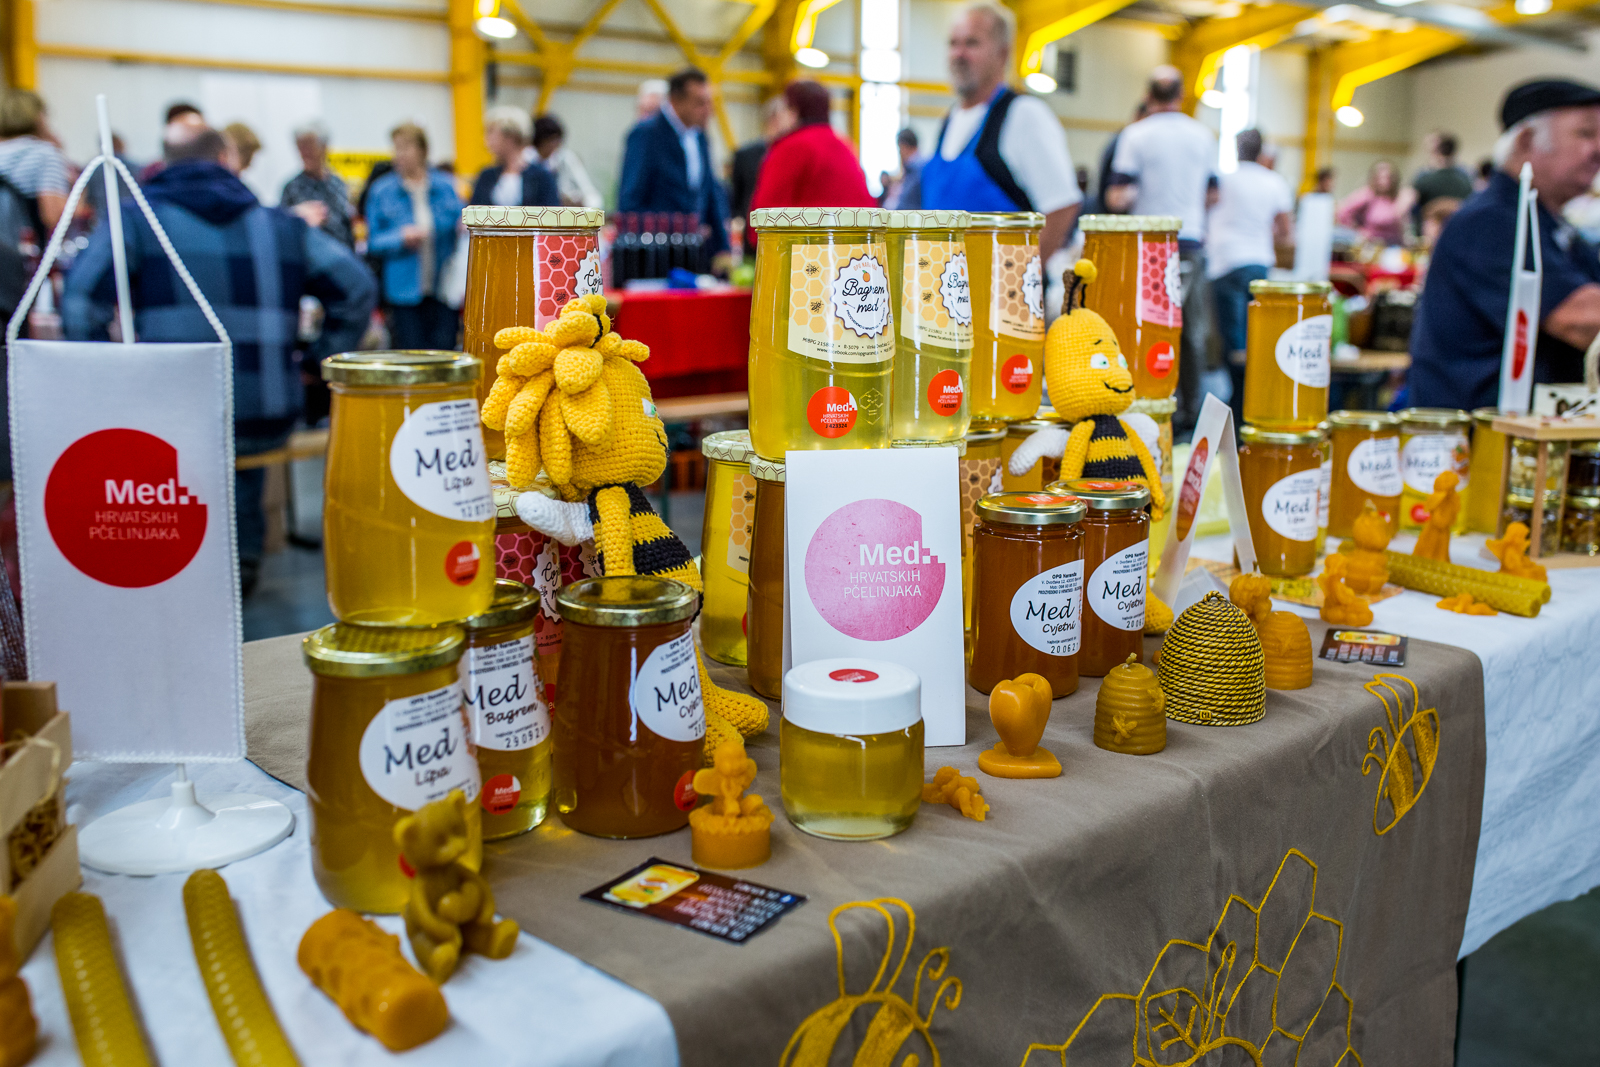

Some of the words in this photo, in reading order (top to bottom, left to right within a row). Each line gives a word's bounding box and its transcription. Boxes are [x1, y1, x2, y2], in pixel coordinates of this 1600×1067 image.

[842, 277, 885, 302] Bagrem
[856, 297, 879, 313] med
[414, 438, 480, 477] Med
[94, 510, 179, 524] HRVATSKIH
[88, 524, 181, 540] PČELINJAKA
[850, 570, 921, 584] HRVATSKIH
[1102, 575, 1144, 600] Med
[843, 584, 922, 599] PČELINJAKA
[1026, 597, 1076, 621] Med
[1042, 620, 1077, 636] Cvjetni
[654, 665, 698, 712] Med
[484, 702, 539, 725] Bagrem
[384, 725, 459, 774] Med
